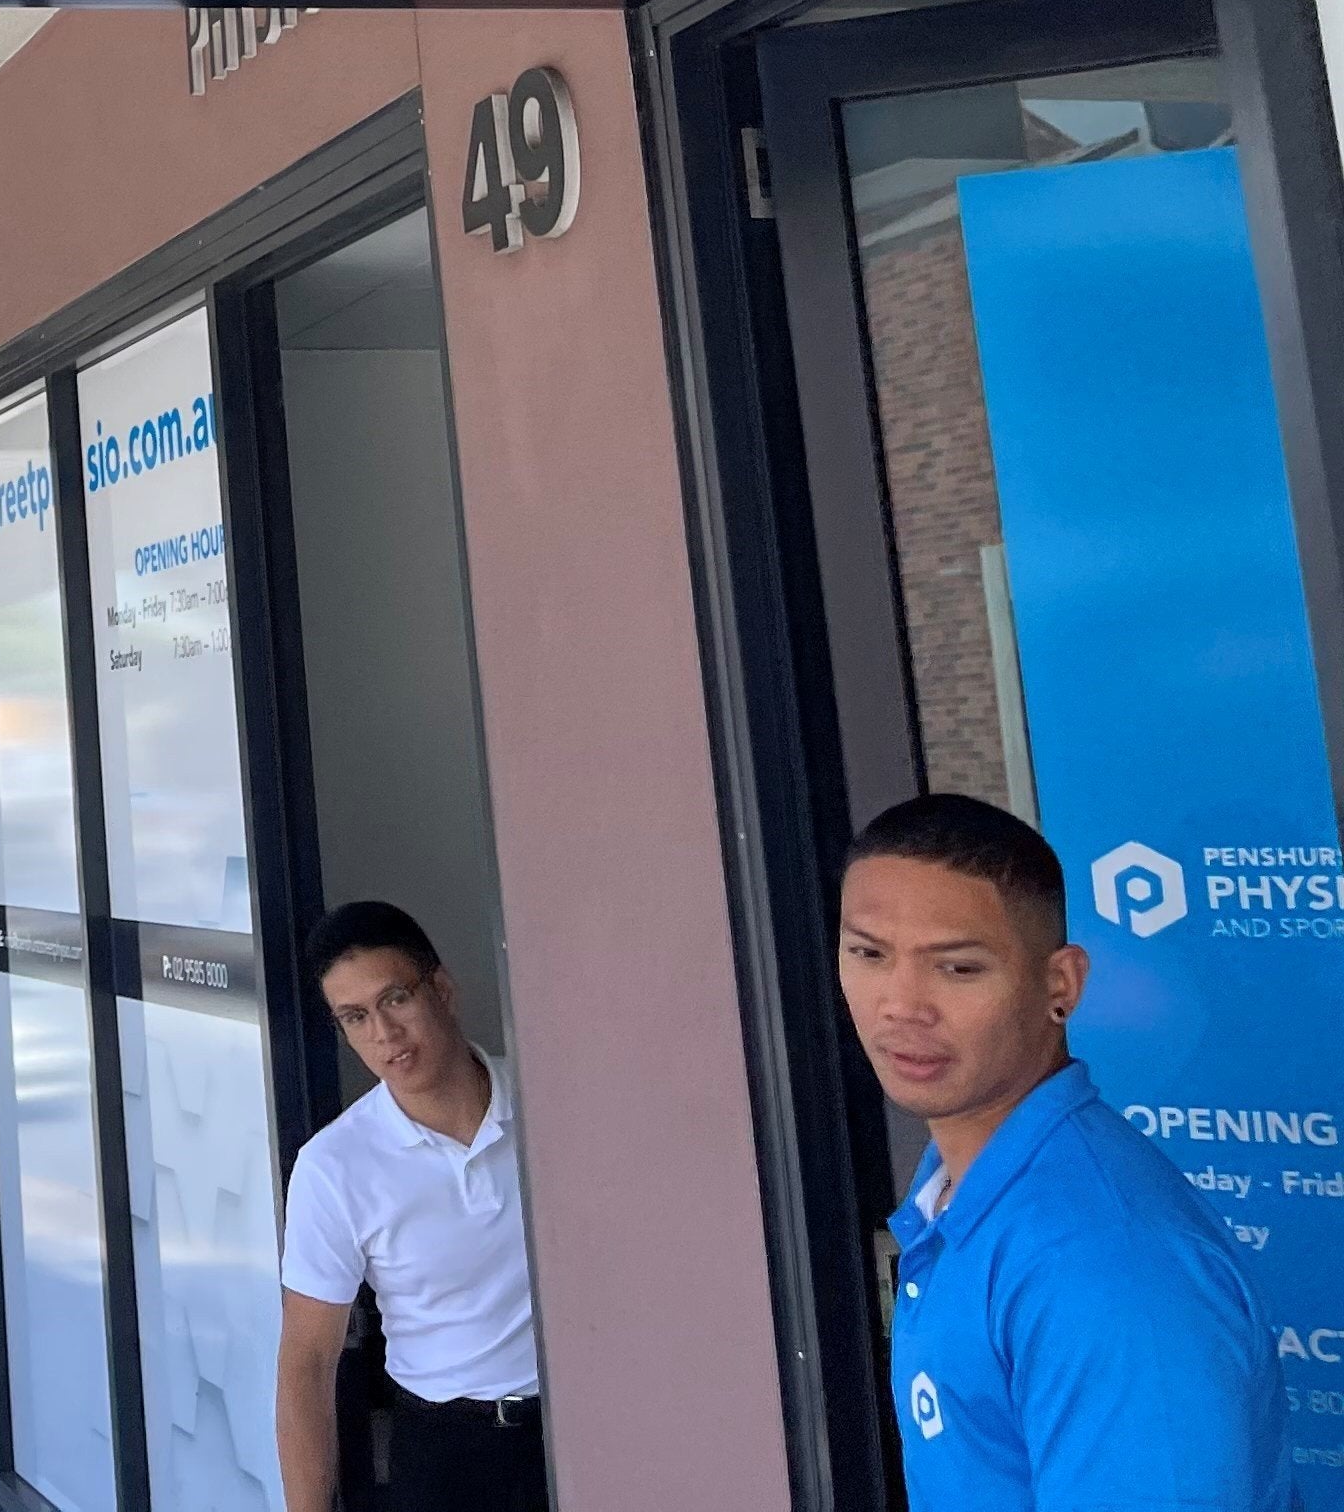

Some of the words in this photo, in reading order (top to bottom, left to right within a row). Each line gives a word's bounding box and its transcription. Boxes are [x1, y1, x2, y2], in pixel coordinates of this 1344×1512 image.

[462, 66, 582, 255] 49
[134, 534, 188, 576] OPENING
[107, 601, 136, 629] Monday
[142, 594, 167, 623] Friday
[169, 588, 200, 613] 7:30am
[109, 643, 143, 672] Saturday
[172, 635, 203, 659] 7:30am
[1202, 847, 1342, 867] PENSHUR
[1211, 918, 1271, 937] AND
[173, 955, 185, 981] 02
[185, 958, 205, 985] 9585
[205, 961, 228, 989] 8000
[1124, 1104, 1338, 1147] OPENING
